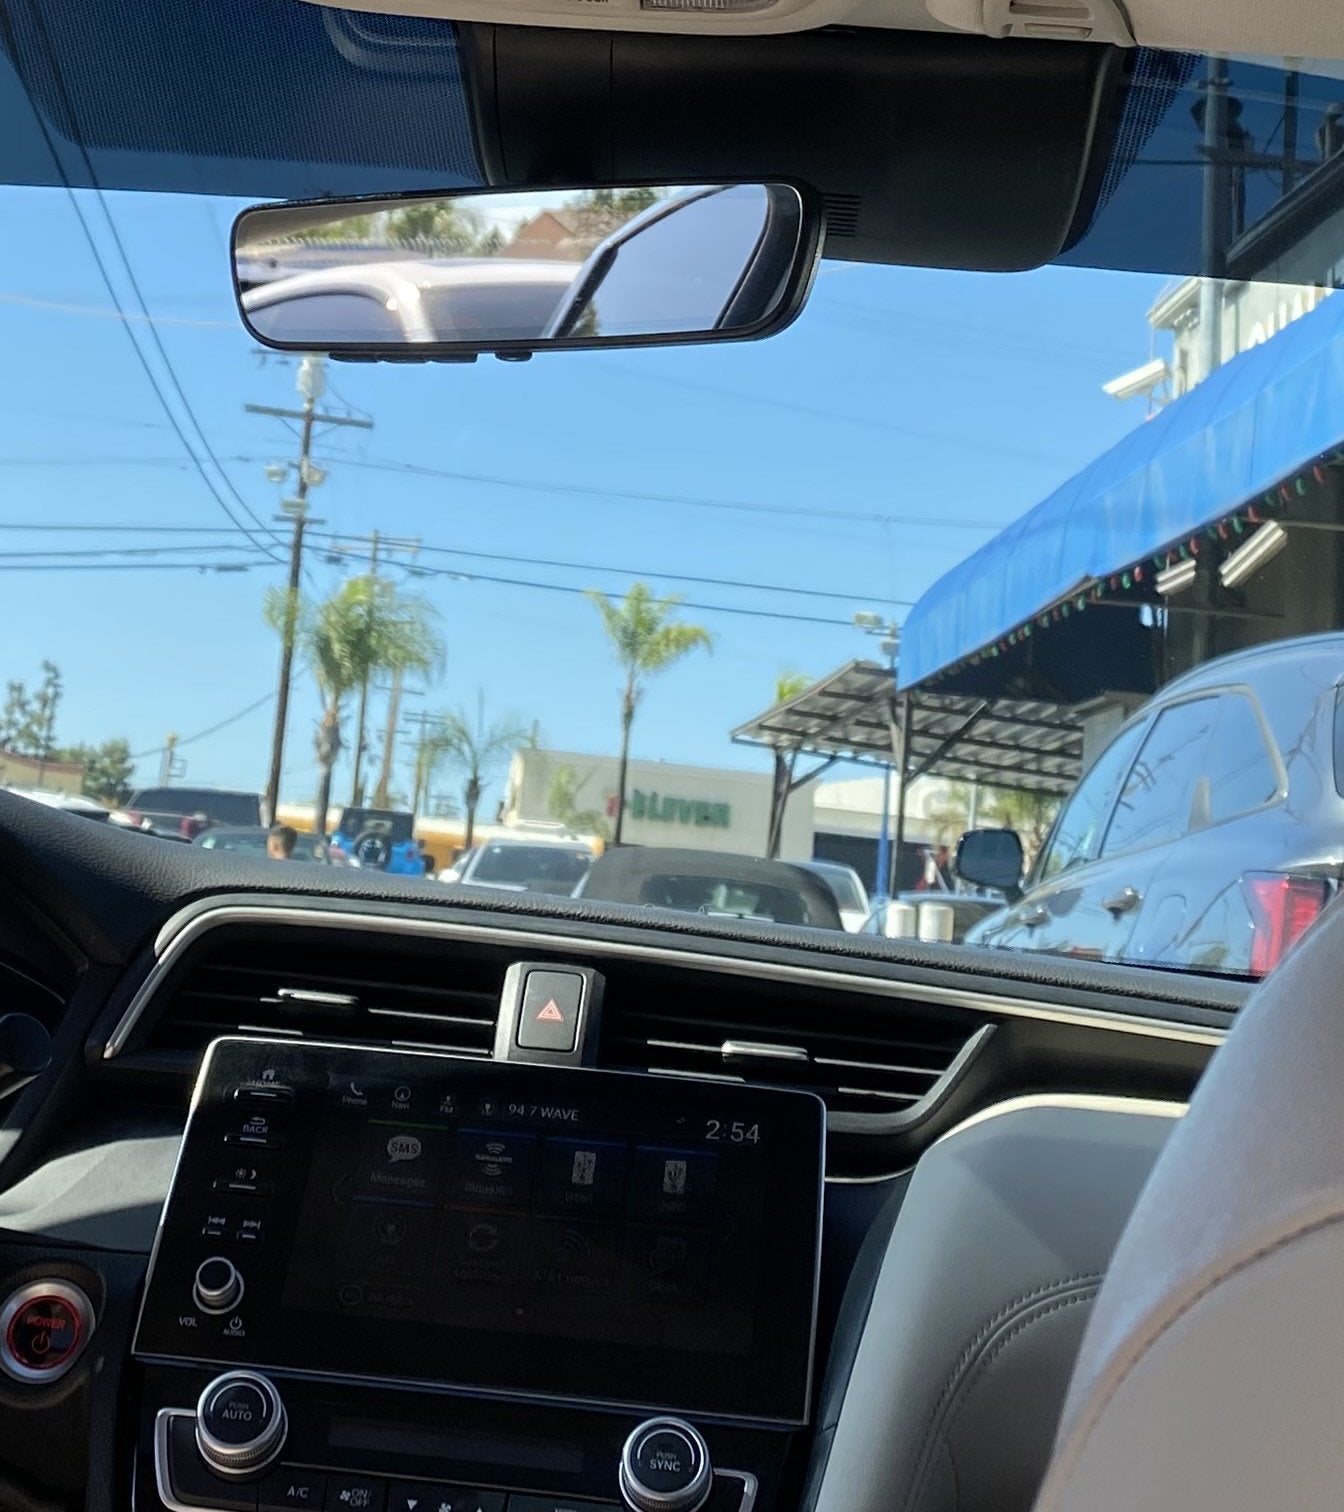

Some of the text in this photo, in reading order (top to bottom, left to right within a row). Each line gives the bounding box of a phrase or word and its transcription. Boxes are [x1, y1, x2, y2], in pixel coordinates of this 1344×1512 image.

[540, 1107, 579, 1121] WAVE
[242, 1124, 268, 1134] BACK
[705, 1119, 760, 1144] 2:54
[391, 1142, 417, 1155] SMS
[27, 1315, 65, 1329] POWER
[178, 1317, 198, 1327] VOL
[222, 1408, 253, 1421] AUTO
[649, 1458, 681, 1473] SYNC
[287, 1485, 309, 1499] A/C
[348, 1498, 370, 1508] OFF
